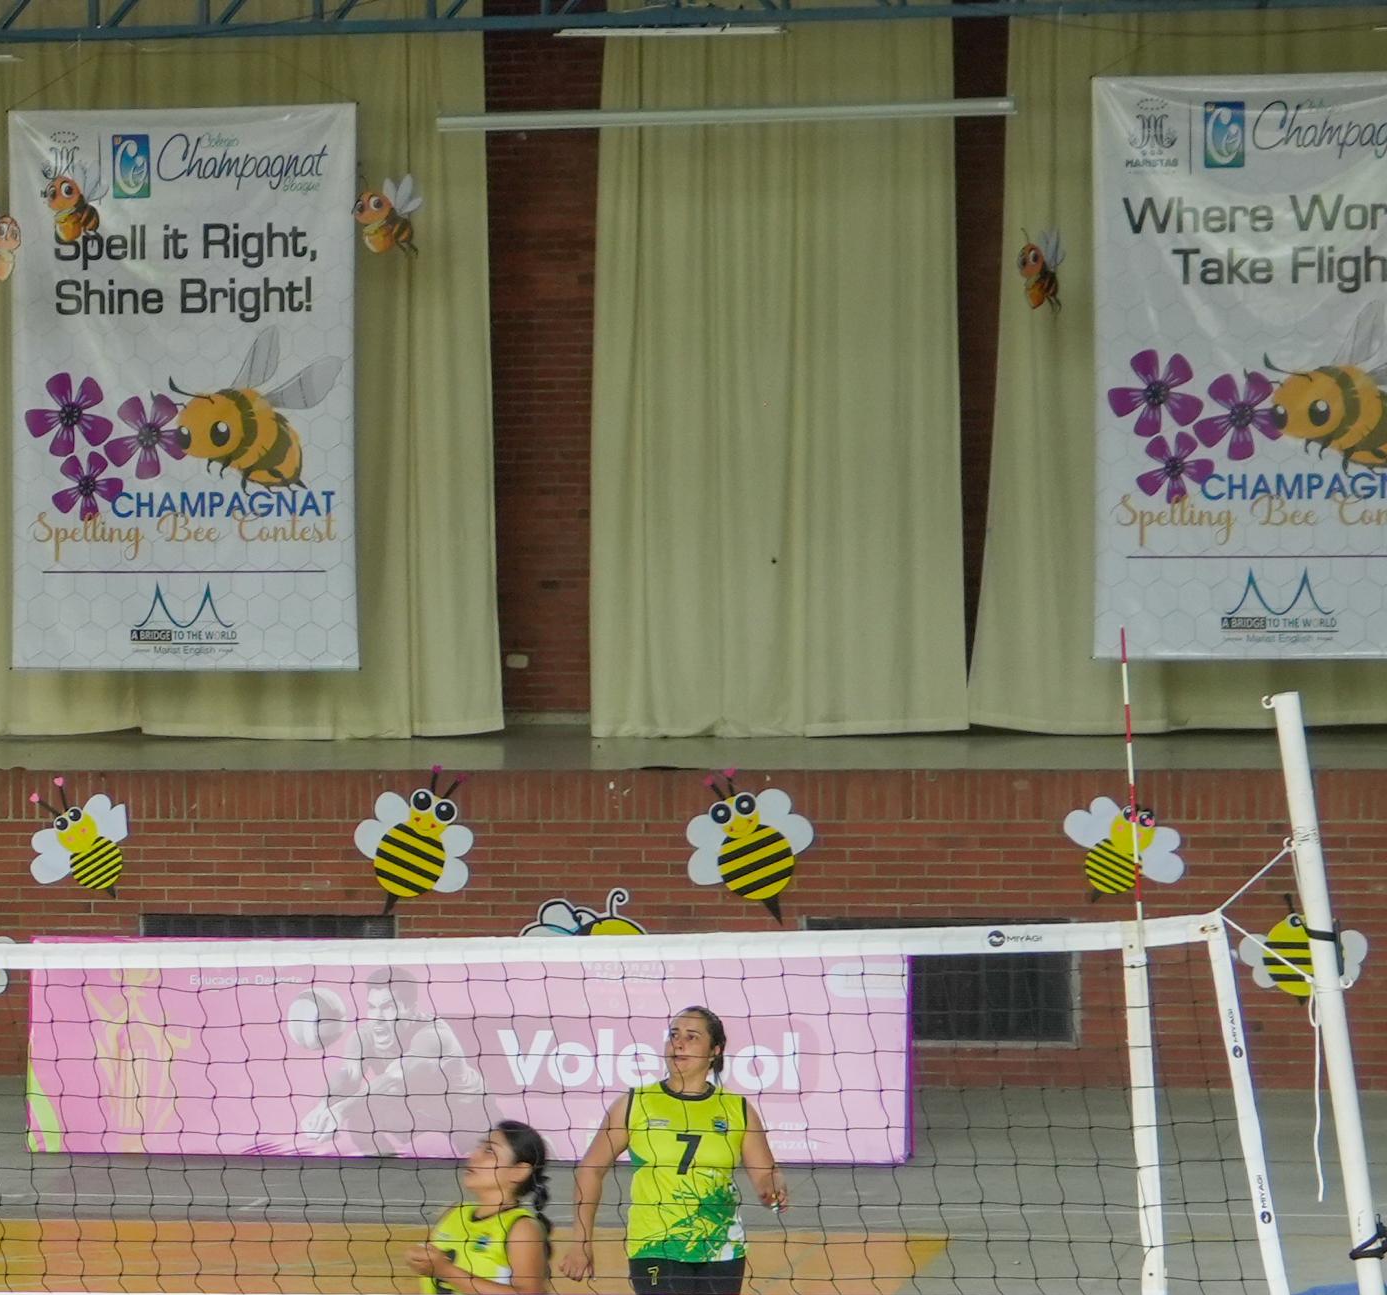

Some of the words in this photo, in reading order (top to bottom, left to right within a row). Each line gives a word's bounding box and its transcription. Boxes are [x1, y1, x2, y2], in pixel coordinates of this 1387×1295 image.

[156, 133, 328, 191] Champagnat
[1122, 196, 1274, 235] Where
[162, 224, 188, 260] it
[202, 222, 318, 269] Right,
[1172, 248, 1274, 286] Take
[1291, 246, 1387, 294] Fligh
[55, 279, 164, 316] Shine
[180, 276, 313, 323] Bright!
[111, 490, 336, 519] CHAMPAGNAT
[1111, 494, 1235, 547] Spelling
[1250, 494, 1318, 526] Bee
[30, 510, 145, 561] Spelling
[156, 510, 221, 543] Bee
[234, 504, 338, 543] Contest
[139, 630, 172, 640] BRIDGE
[174, 631, 184, 640] TO
[187, 631, 202, 640] THE
[205, 631, 237, 640] WORLD
[1230, 617, 1266, 628] BRIDGE
[1282, 618, 1299, 628] THE
[1302, 618, 1337, 628] WORLD
[497, 1028, 800, 1091] Voleol
[676, 1133, 703, 1176] 7
